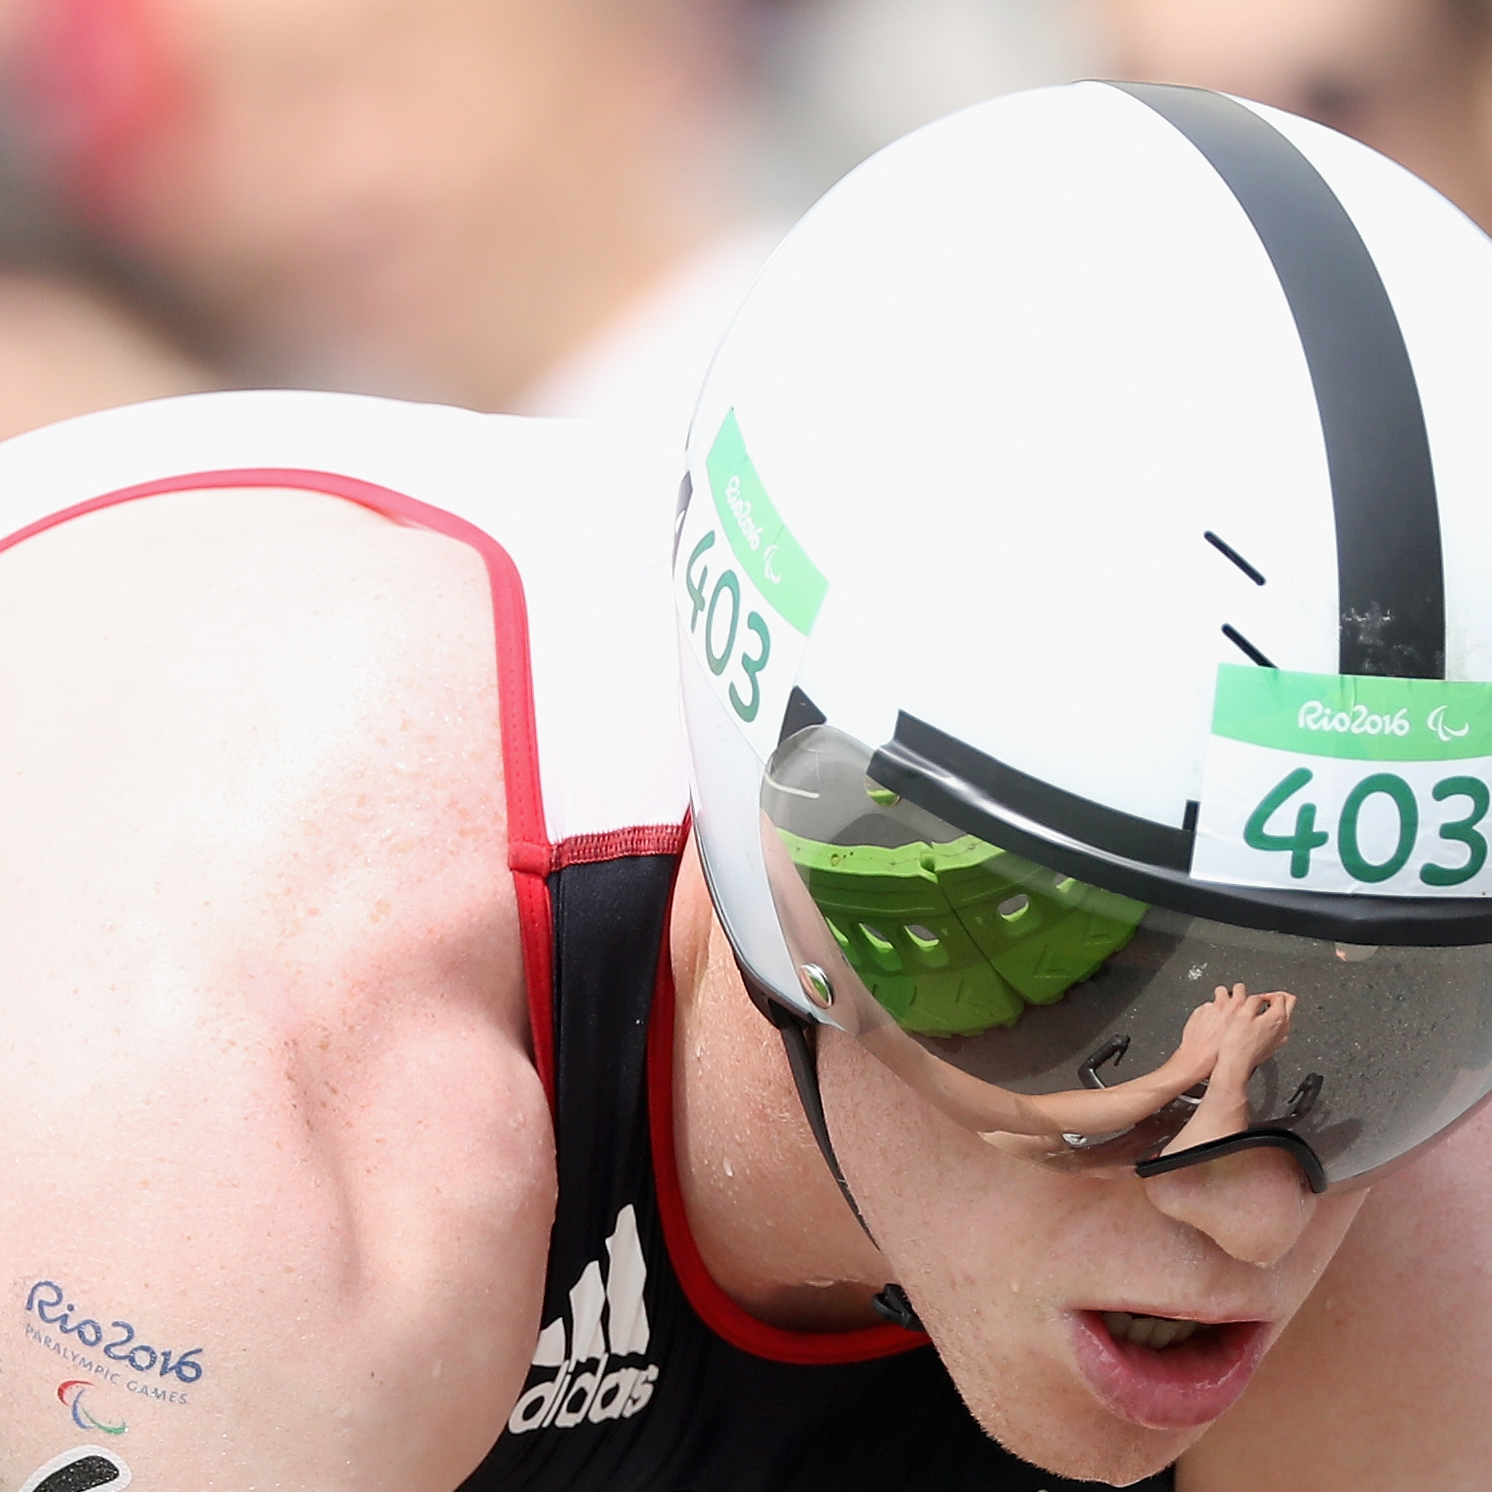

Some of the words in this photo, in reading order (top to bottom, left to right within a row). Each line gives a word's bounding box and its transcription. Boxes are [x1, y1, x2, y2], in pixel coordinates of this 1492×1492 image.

[686, 528, 771, 724] 403
[1297, 699, 1412, 738] Rio2016
[1242, 766, 1492, 888] 403
[24, 1322, 122, 1386] PARALYMPIC
[125, 1379, 190, 1406] GAMES
[25, 1280, 205, 1384] Rio2016
